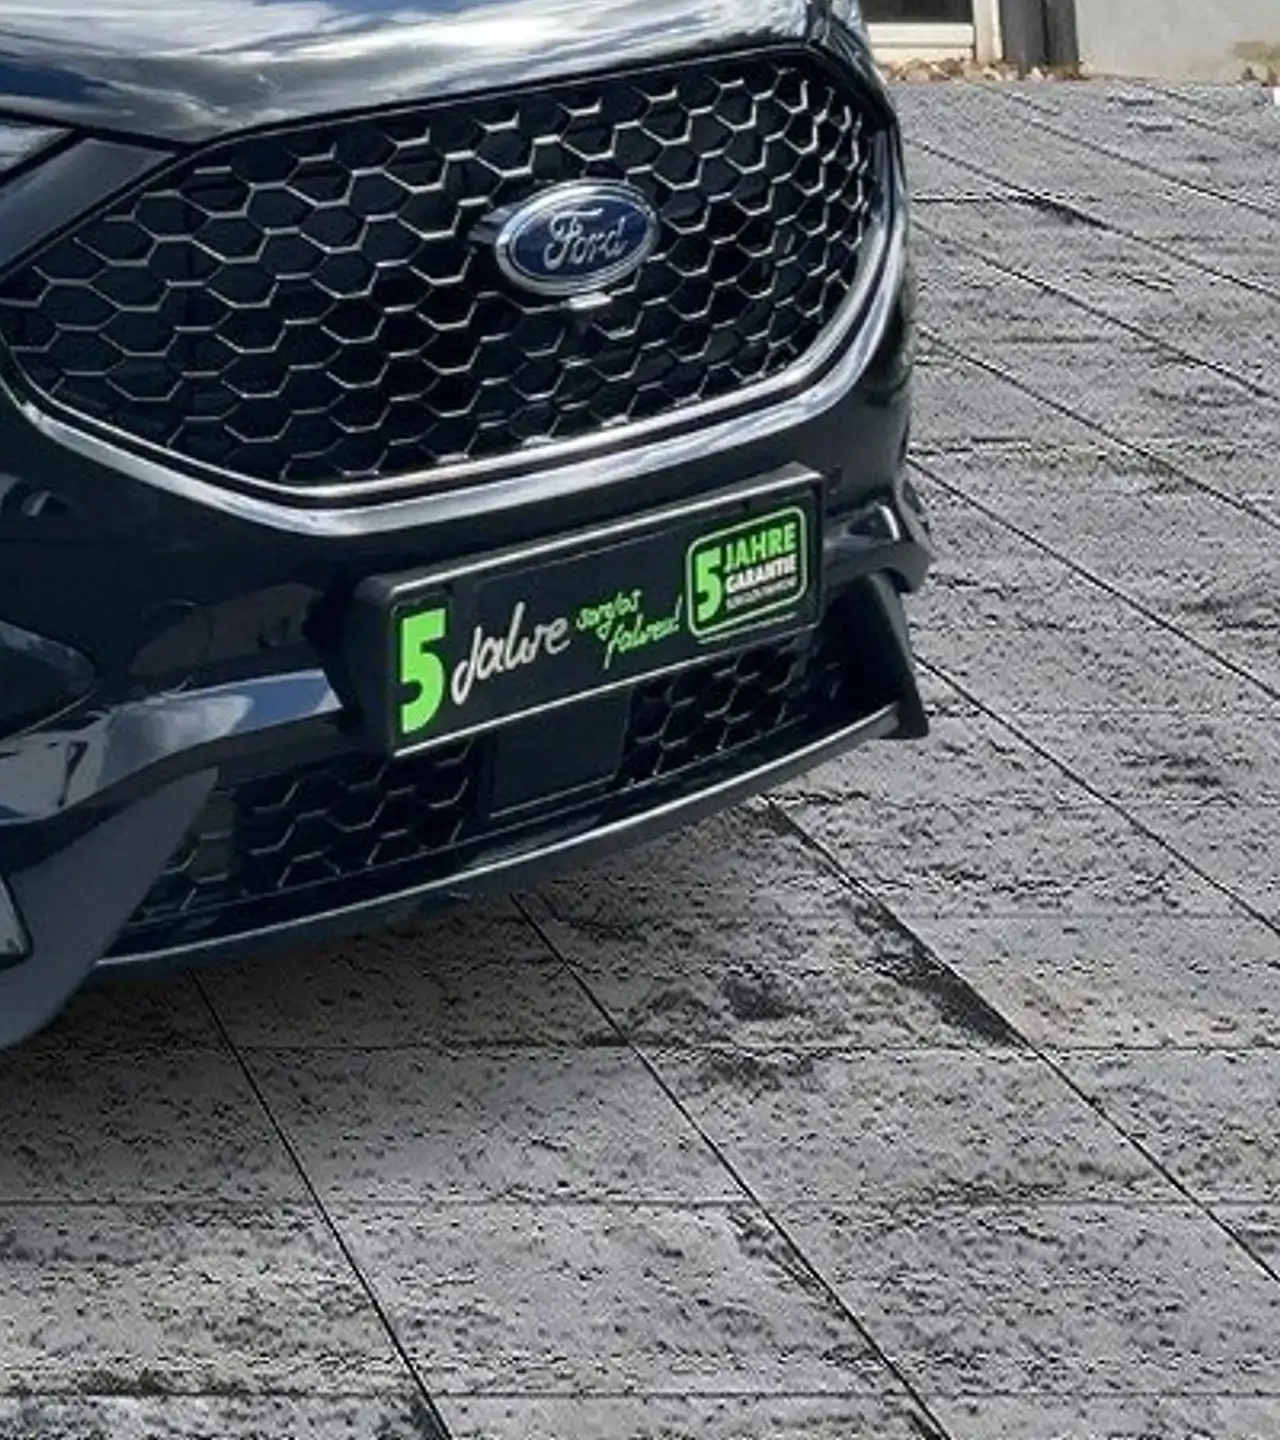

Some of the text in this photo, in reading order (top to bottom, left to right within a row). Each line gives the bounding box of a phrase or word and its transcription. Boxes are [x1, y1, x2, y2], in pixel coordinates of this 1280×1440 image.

[543, 207, 629, 271] Ford
[697, 546, 721, 622] 5
[723, 521, 797, 573] JAHRE
[402, 601, 571, 733] 5 Jahre
